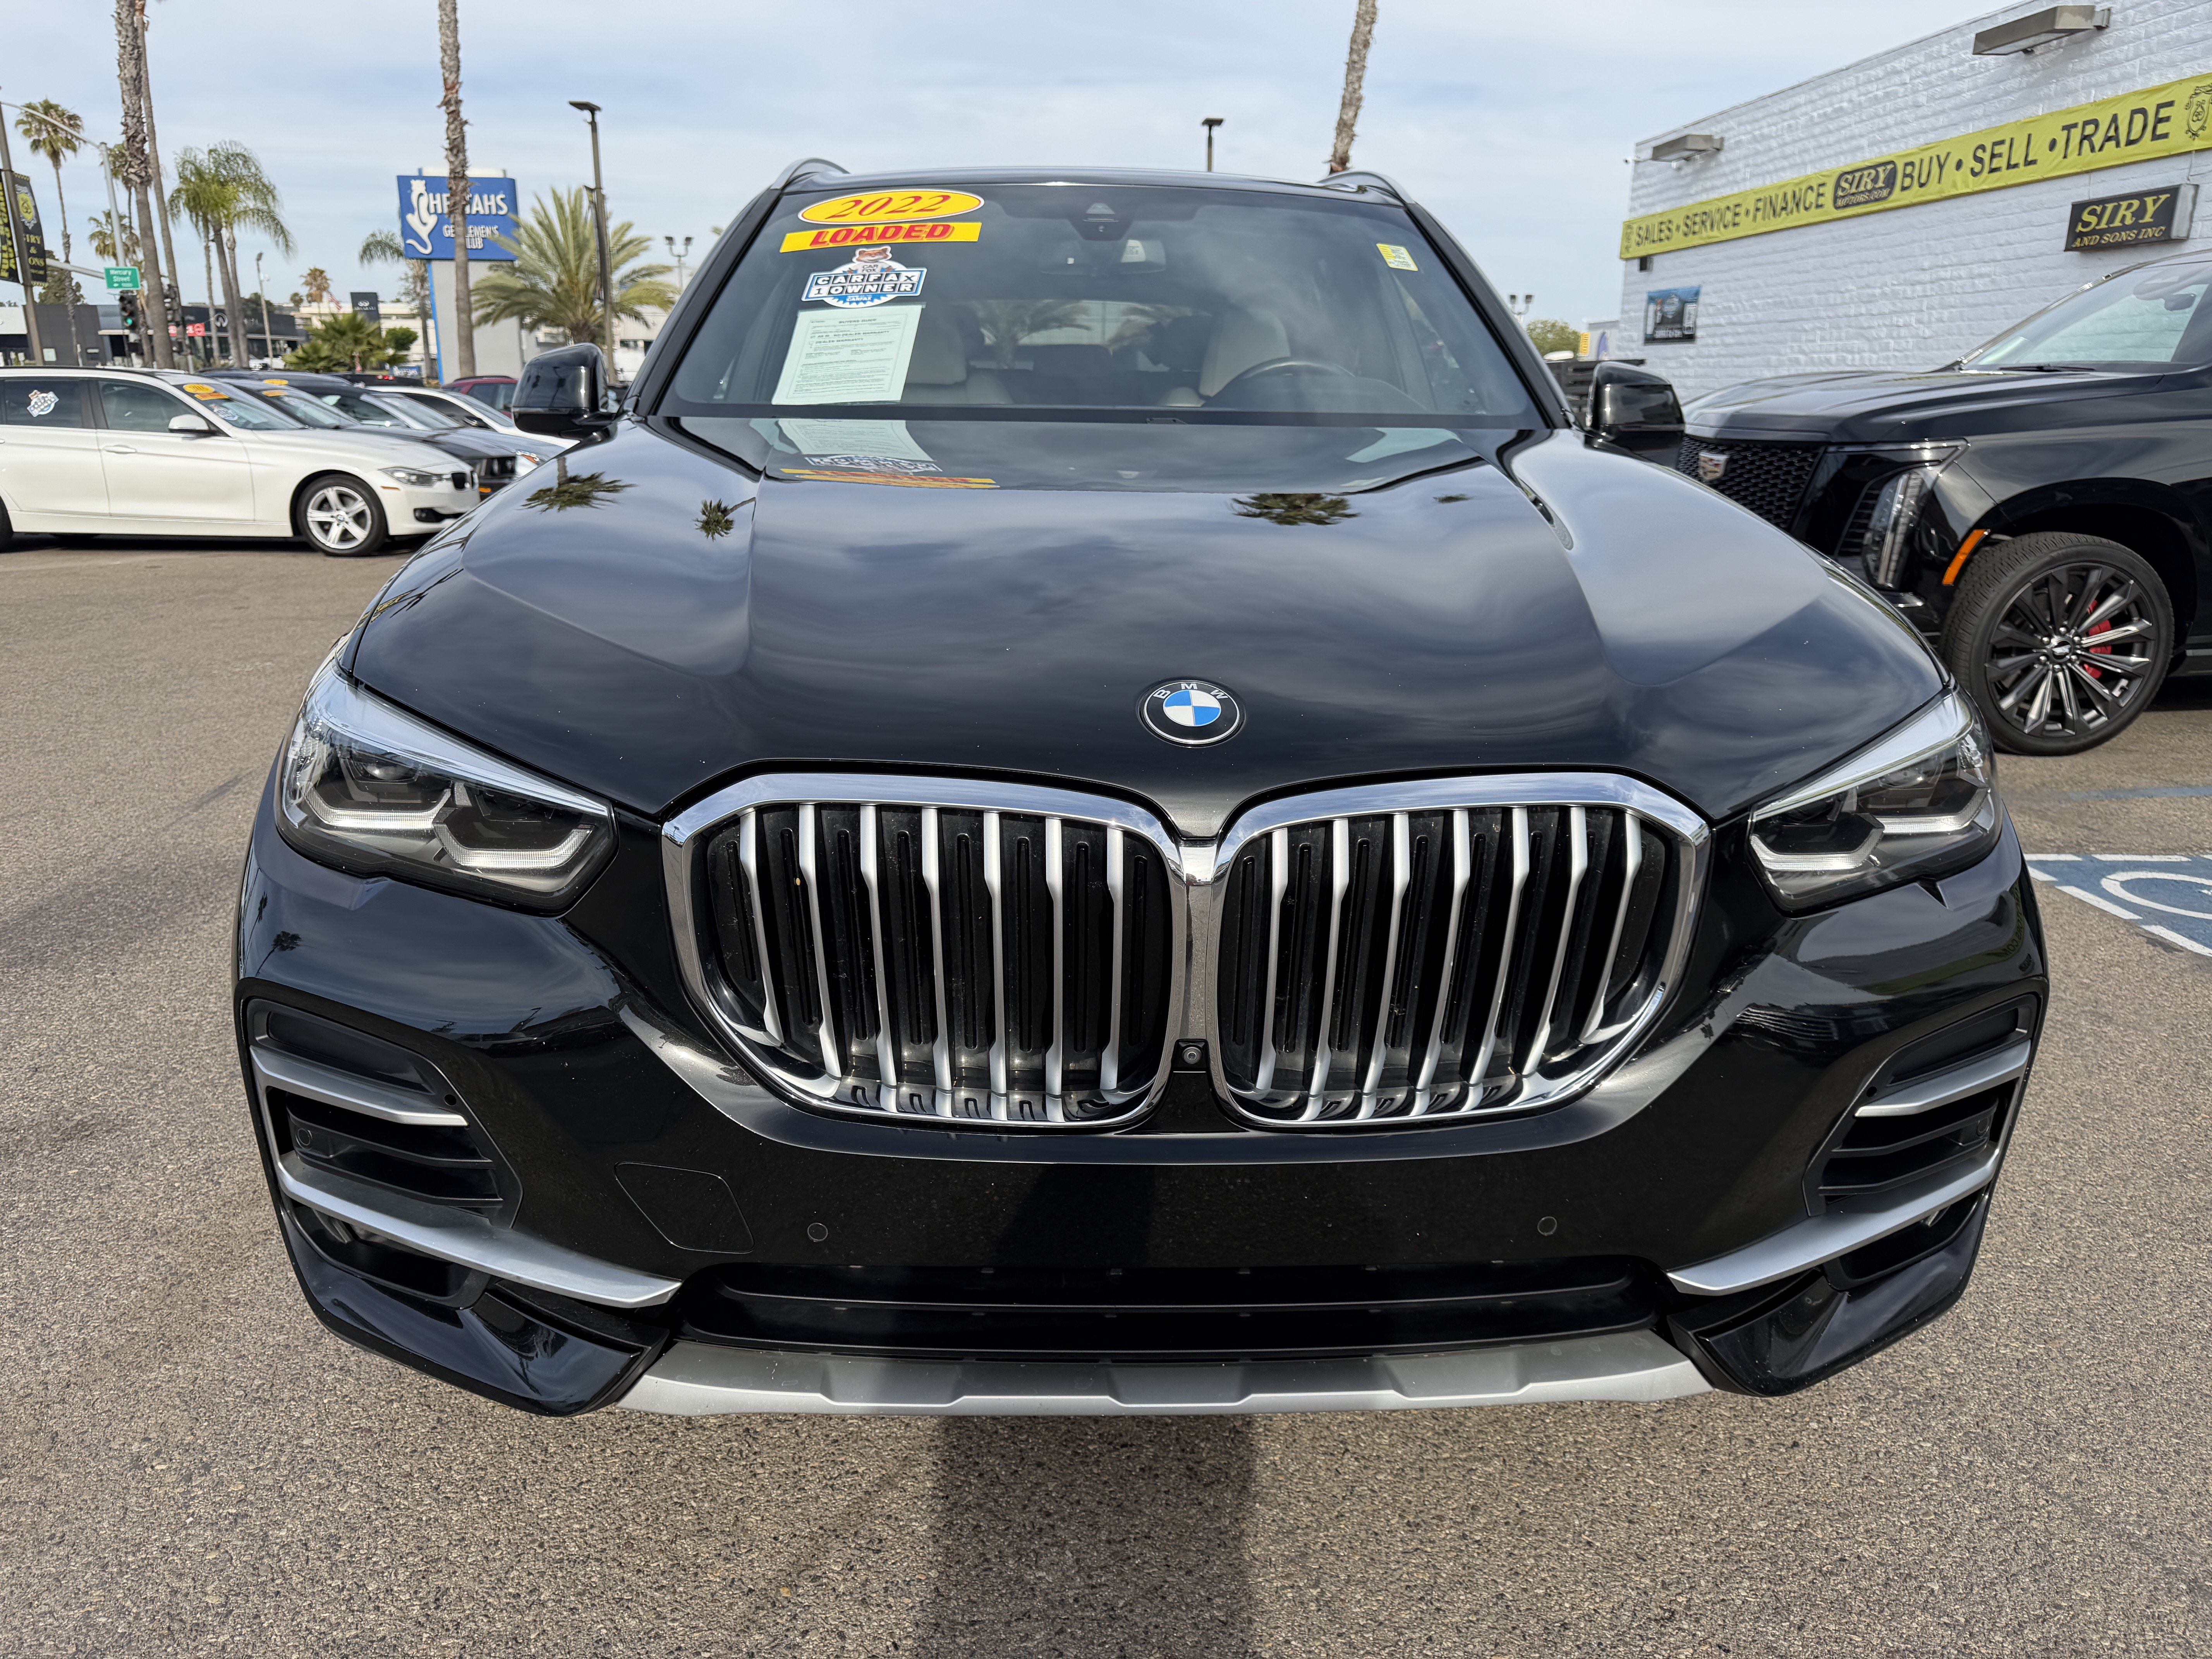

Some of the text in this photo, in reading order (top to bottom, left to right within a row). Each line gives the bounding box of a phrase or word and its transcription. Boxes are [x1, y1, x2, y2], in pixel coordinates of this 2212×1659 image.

[1901, 100, 2175, 192] BUY SELL TRADE
[1836, 164, 1894, 196] SIRY
[824, 195, 950, 219] 2022
[1635, 182, 1827, 247] SALES SERVICE FINANCE
[2075, 194, 2170, 232] SIRY
[810, 224, 954, 247] LOADED
[2072, 226, 2166, 247] AND SONS INC
[817, 274, 915, 285] CARFAX
[1153, 683, 1228, 699] BMW
